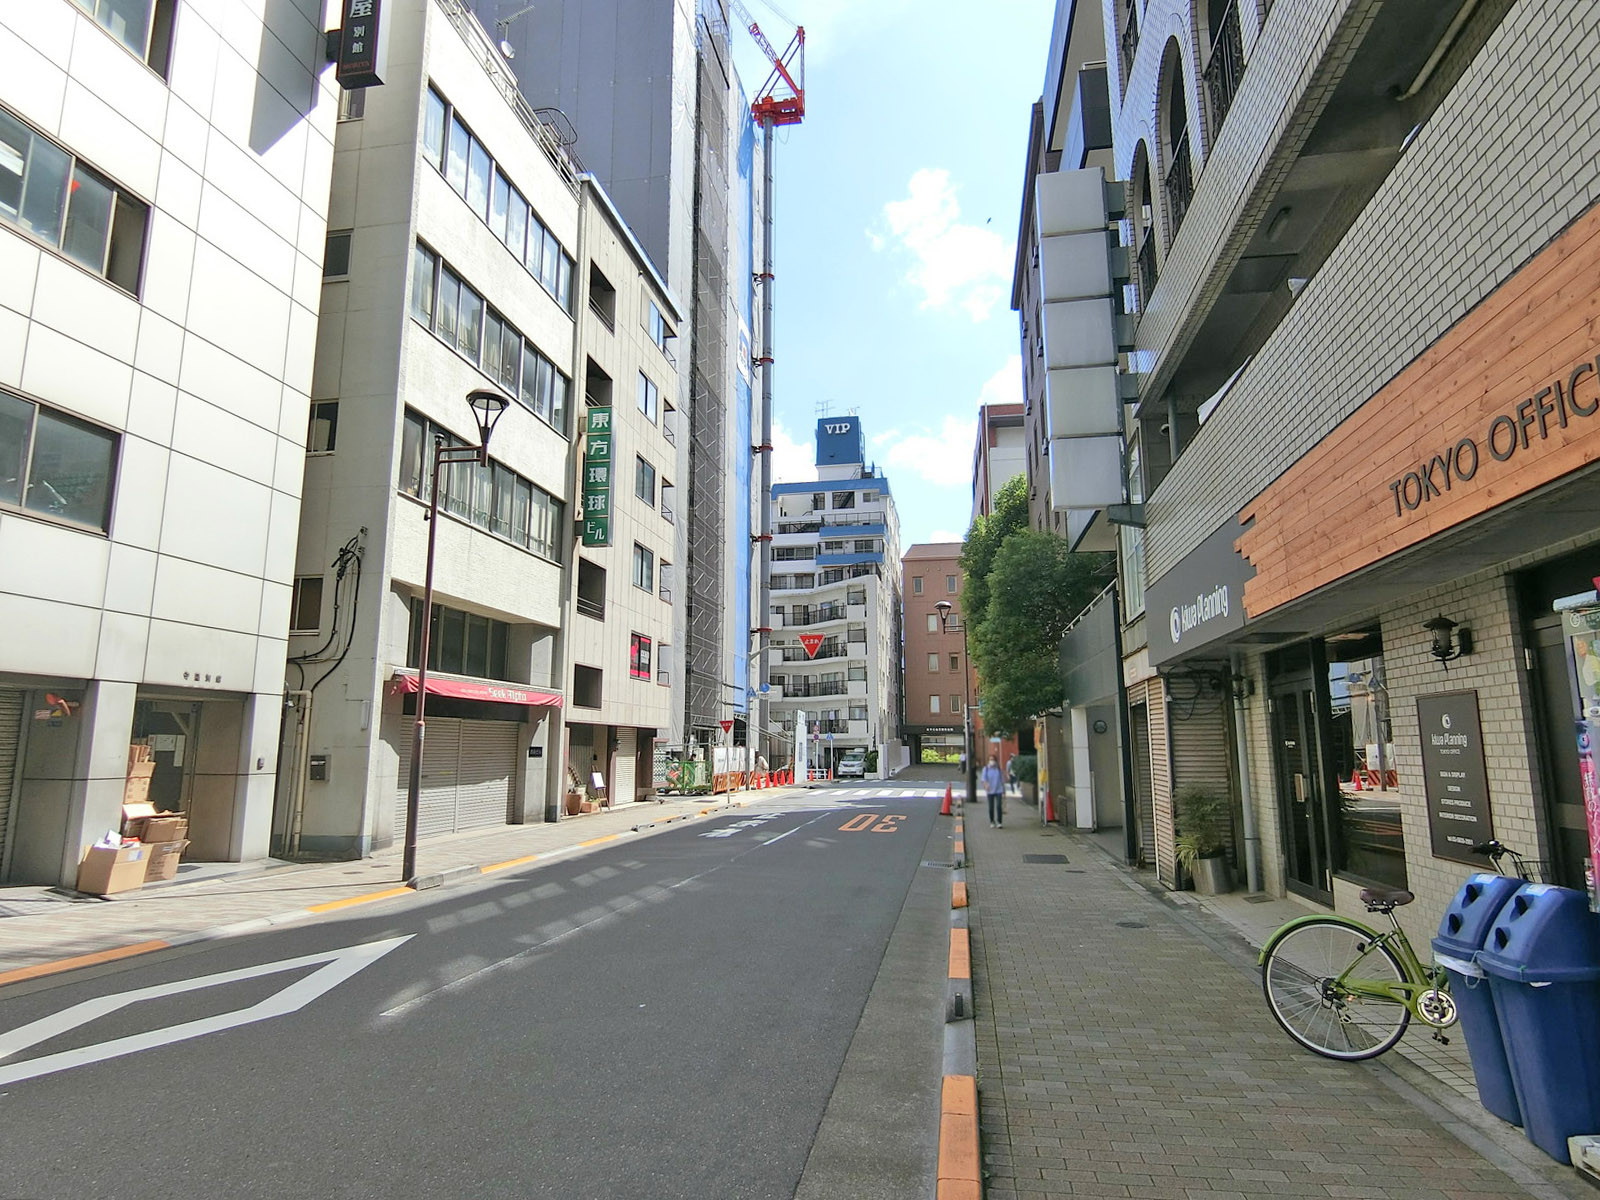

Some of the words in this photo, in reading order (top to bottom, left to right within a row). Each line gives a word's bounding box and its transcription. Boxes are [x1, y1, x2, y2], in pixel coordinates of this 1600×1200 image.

[825, 423, 850, 434] VIP
[1389, 438, 1478, 517] TOKYO
[1488, 354, 1600, 461] OFFIC
[1197, 585, 1228, 625] Planning
[1444, 732, 1467, 747] Planning
[838, 813, 907, 833] 30
